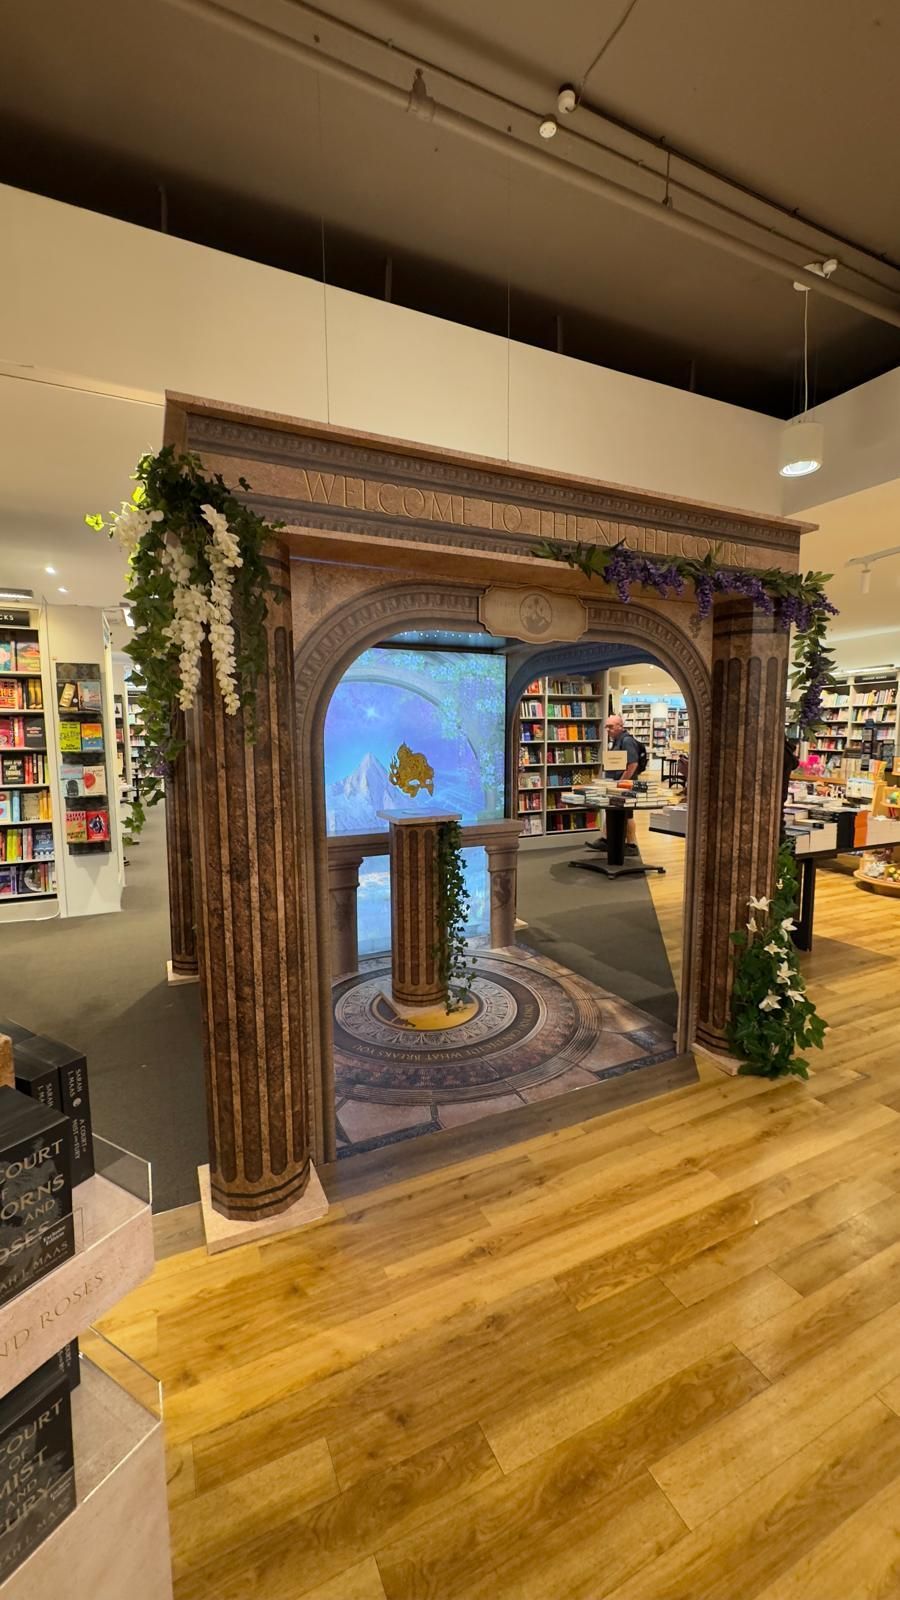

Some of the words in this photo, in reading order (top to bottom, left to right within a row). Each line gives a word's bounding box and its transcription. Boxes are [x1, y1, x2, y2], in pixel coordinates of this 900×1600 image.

[301, 469, 472, 527] WELCOME
[489, 501, 522, 534] TO
[528, 509, 586, 543] THE
[594, 519, 669, 555] NIGHT
[680, 535, 748, 568] COURT
[378, 1049, 420, 1062] BREAKS
[427, 1052, 464, 1062] WHAT
[80, 1125, 88, 1147] COURT
[0, 1173, 65, 1220] ORNS
[24, 1199, 56, 1226] AND
[0, 1220, 50, 1266] OSES
[33, 1240, 69, 1270] MAAS
[40, 1270, 106, 1330] ROSES
[9, 1446, 30, 1470] OF
[6, 1478, 38, 1514] AND
